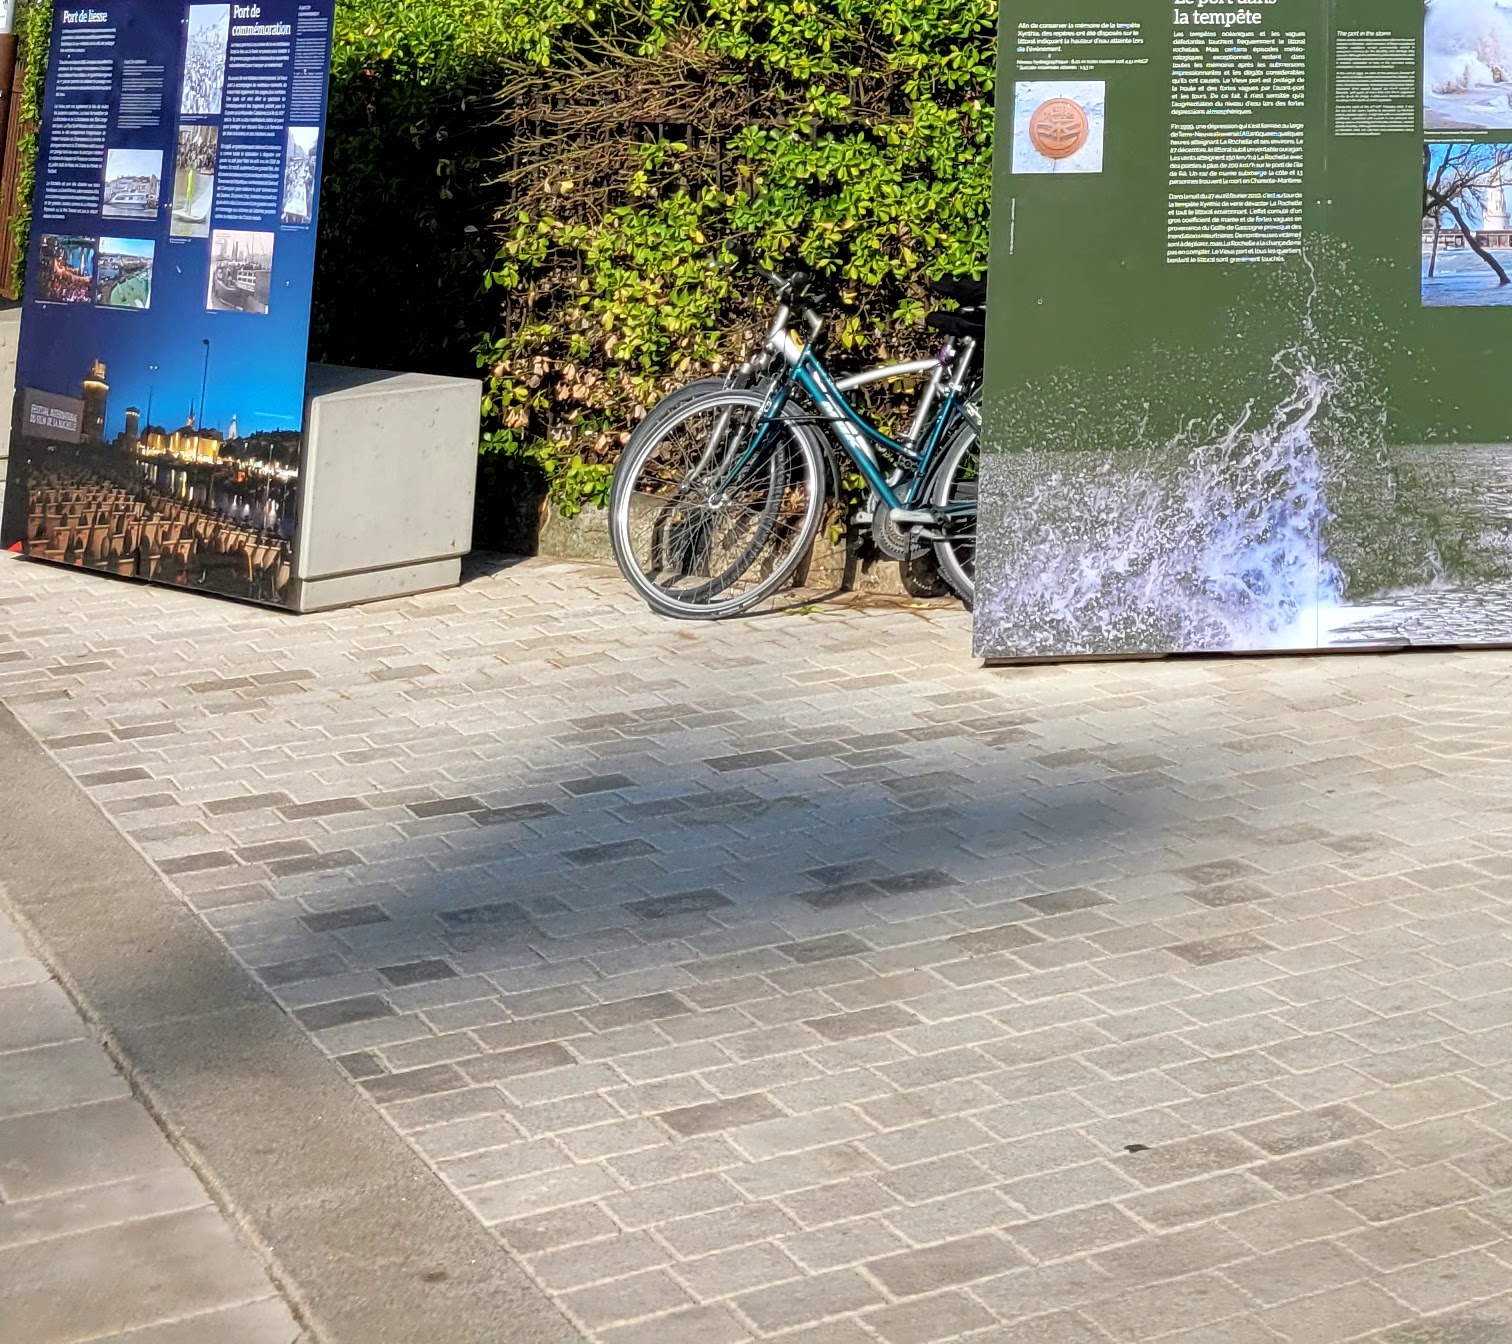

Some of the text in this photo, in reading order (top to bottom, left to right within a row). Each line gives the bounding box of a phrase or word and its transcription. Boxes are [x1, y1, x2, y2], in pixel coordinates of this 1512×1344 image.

[63, 9, 108, 23] Port de liesse
[233, 4, 261, 18] Port de
[1173, 9, 1262, 27] la tempête
[232, 21, 291, 36] commémoration
